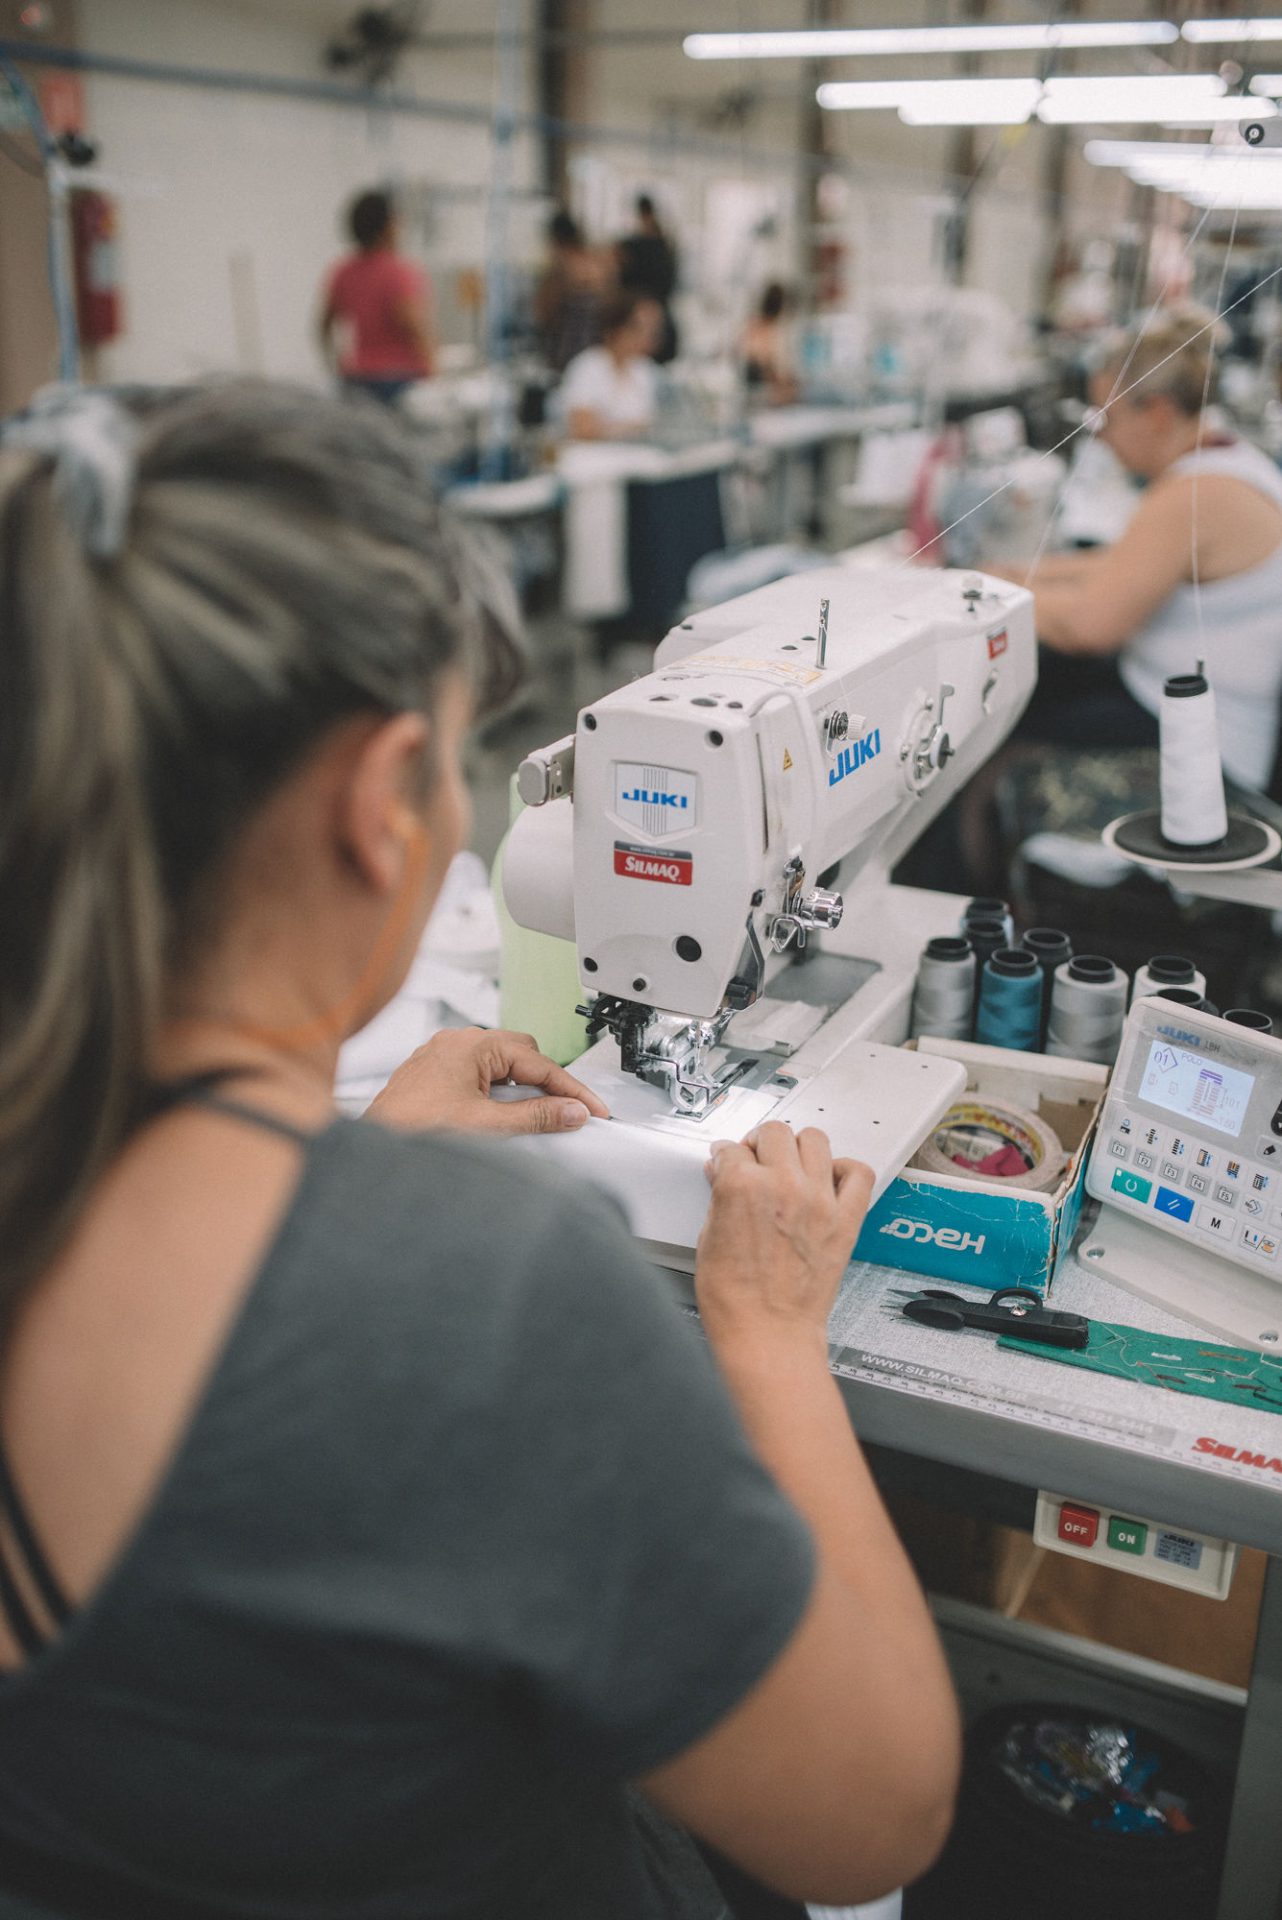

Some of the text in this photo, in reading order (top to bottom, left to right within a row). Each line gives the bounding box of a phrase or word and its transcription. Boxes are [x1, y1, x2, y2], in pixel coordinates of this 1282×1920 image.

[829, 728, 881, 787] JUKI
[622, 789, 688, 809] JUKI
[624, 856, 679, 882] SILMAQ
[1156, 1025, 1200, 1047] JUKI
[1193, 1179, 1202, 1189] F4
[1221, 1191, 1230, 1201] F5
[1210, 1217, 1222, 1230] M
[1064, 1521, 1089, 1536] OFF
[1118, 1532, 1136, 1545] ON
